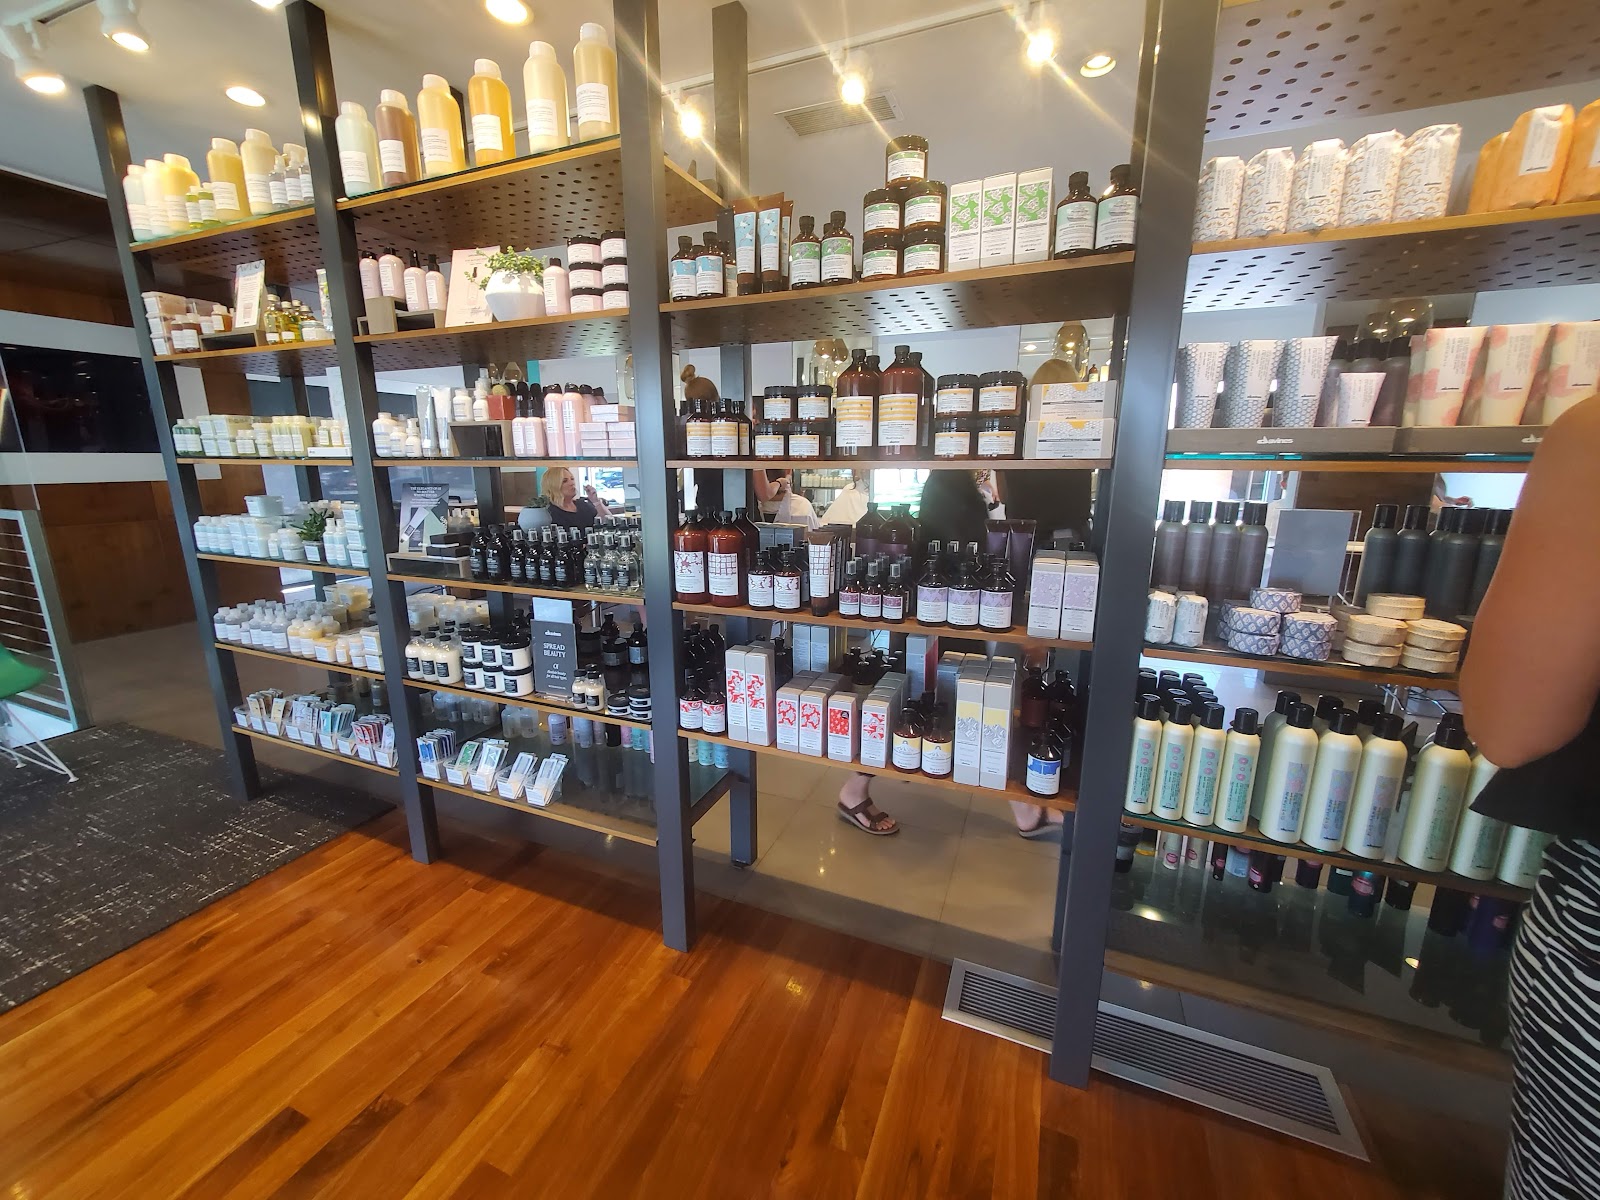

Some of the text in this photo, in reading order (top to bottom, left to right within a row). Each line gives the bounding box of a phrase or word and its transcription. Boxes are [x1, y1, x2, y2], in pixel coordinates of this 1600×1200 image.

[1256, 435, 1294, 444] davines
[543, 642, 566, 651] SPREAD
[543, 649, 567, 658] BEAUTY
